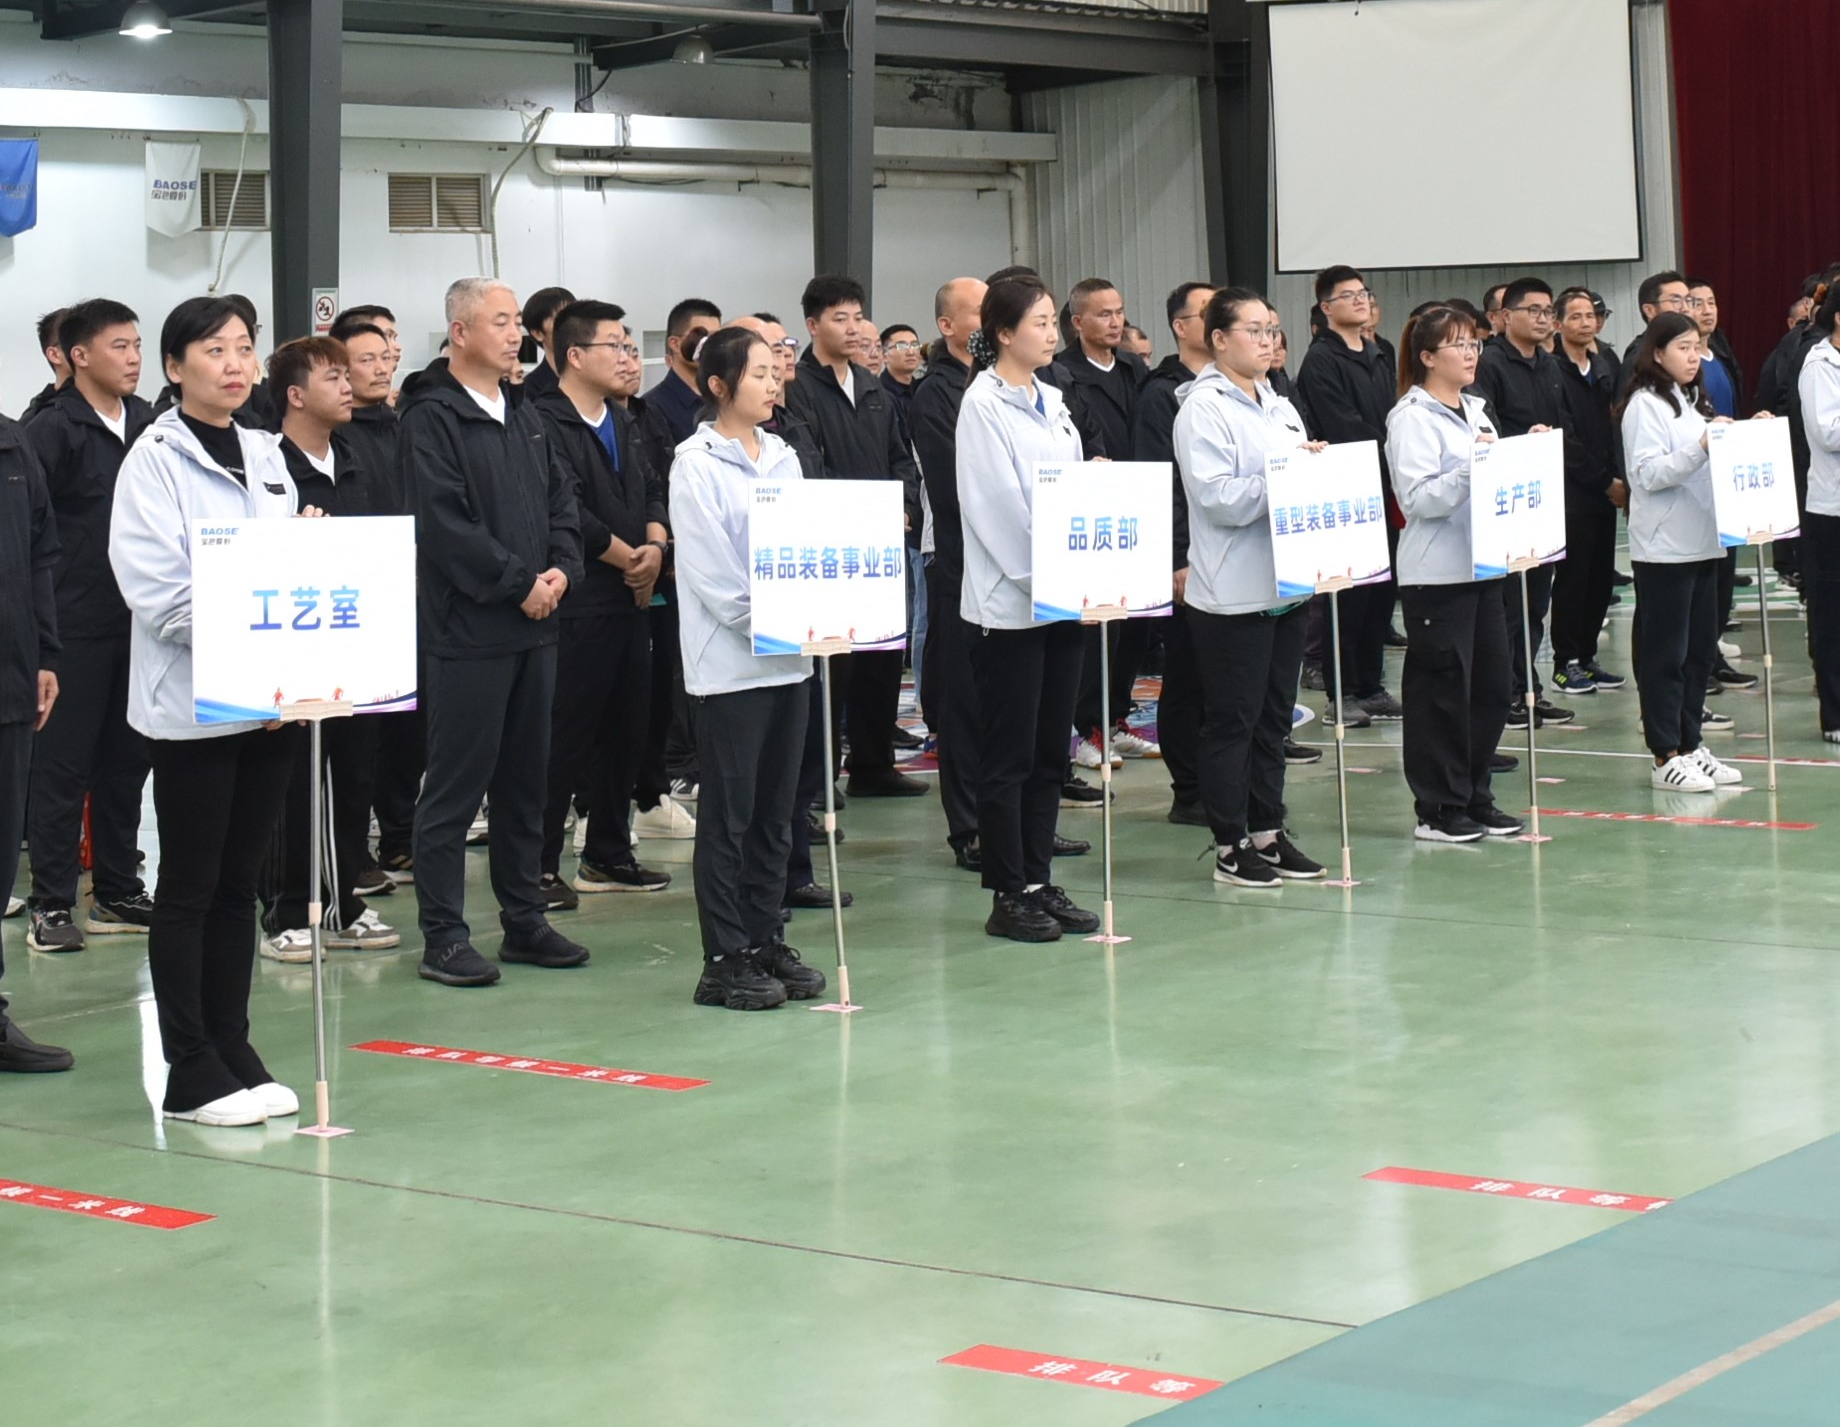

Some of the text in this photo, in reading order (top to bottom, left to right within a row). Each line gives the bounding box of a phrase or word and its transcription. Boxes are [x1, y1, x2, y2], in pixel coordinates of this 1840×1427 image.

[153, 179, 197, 190] BAOSE
[1733, 462, 1774, 492] 行政部
[1273, 496, 1383, 536] 重型装备事业部
[1495, 480, 1541, 517] 生产部
[201, 527, 239, 535] BAOSE
[1068, 515, 1138, 551] 品质部
[754, 546, 902, 581] 精品装备事业部
[250, 585, 360, 631] 工艺室
